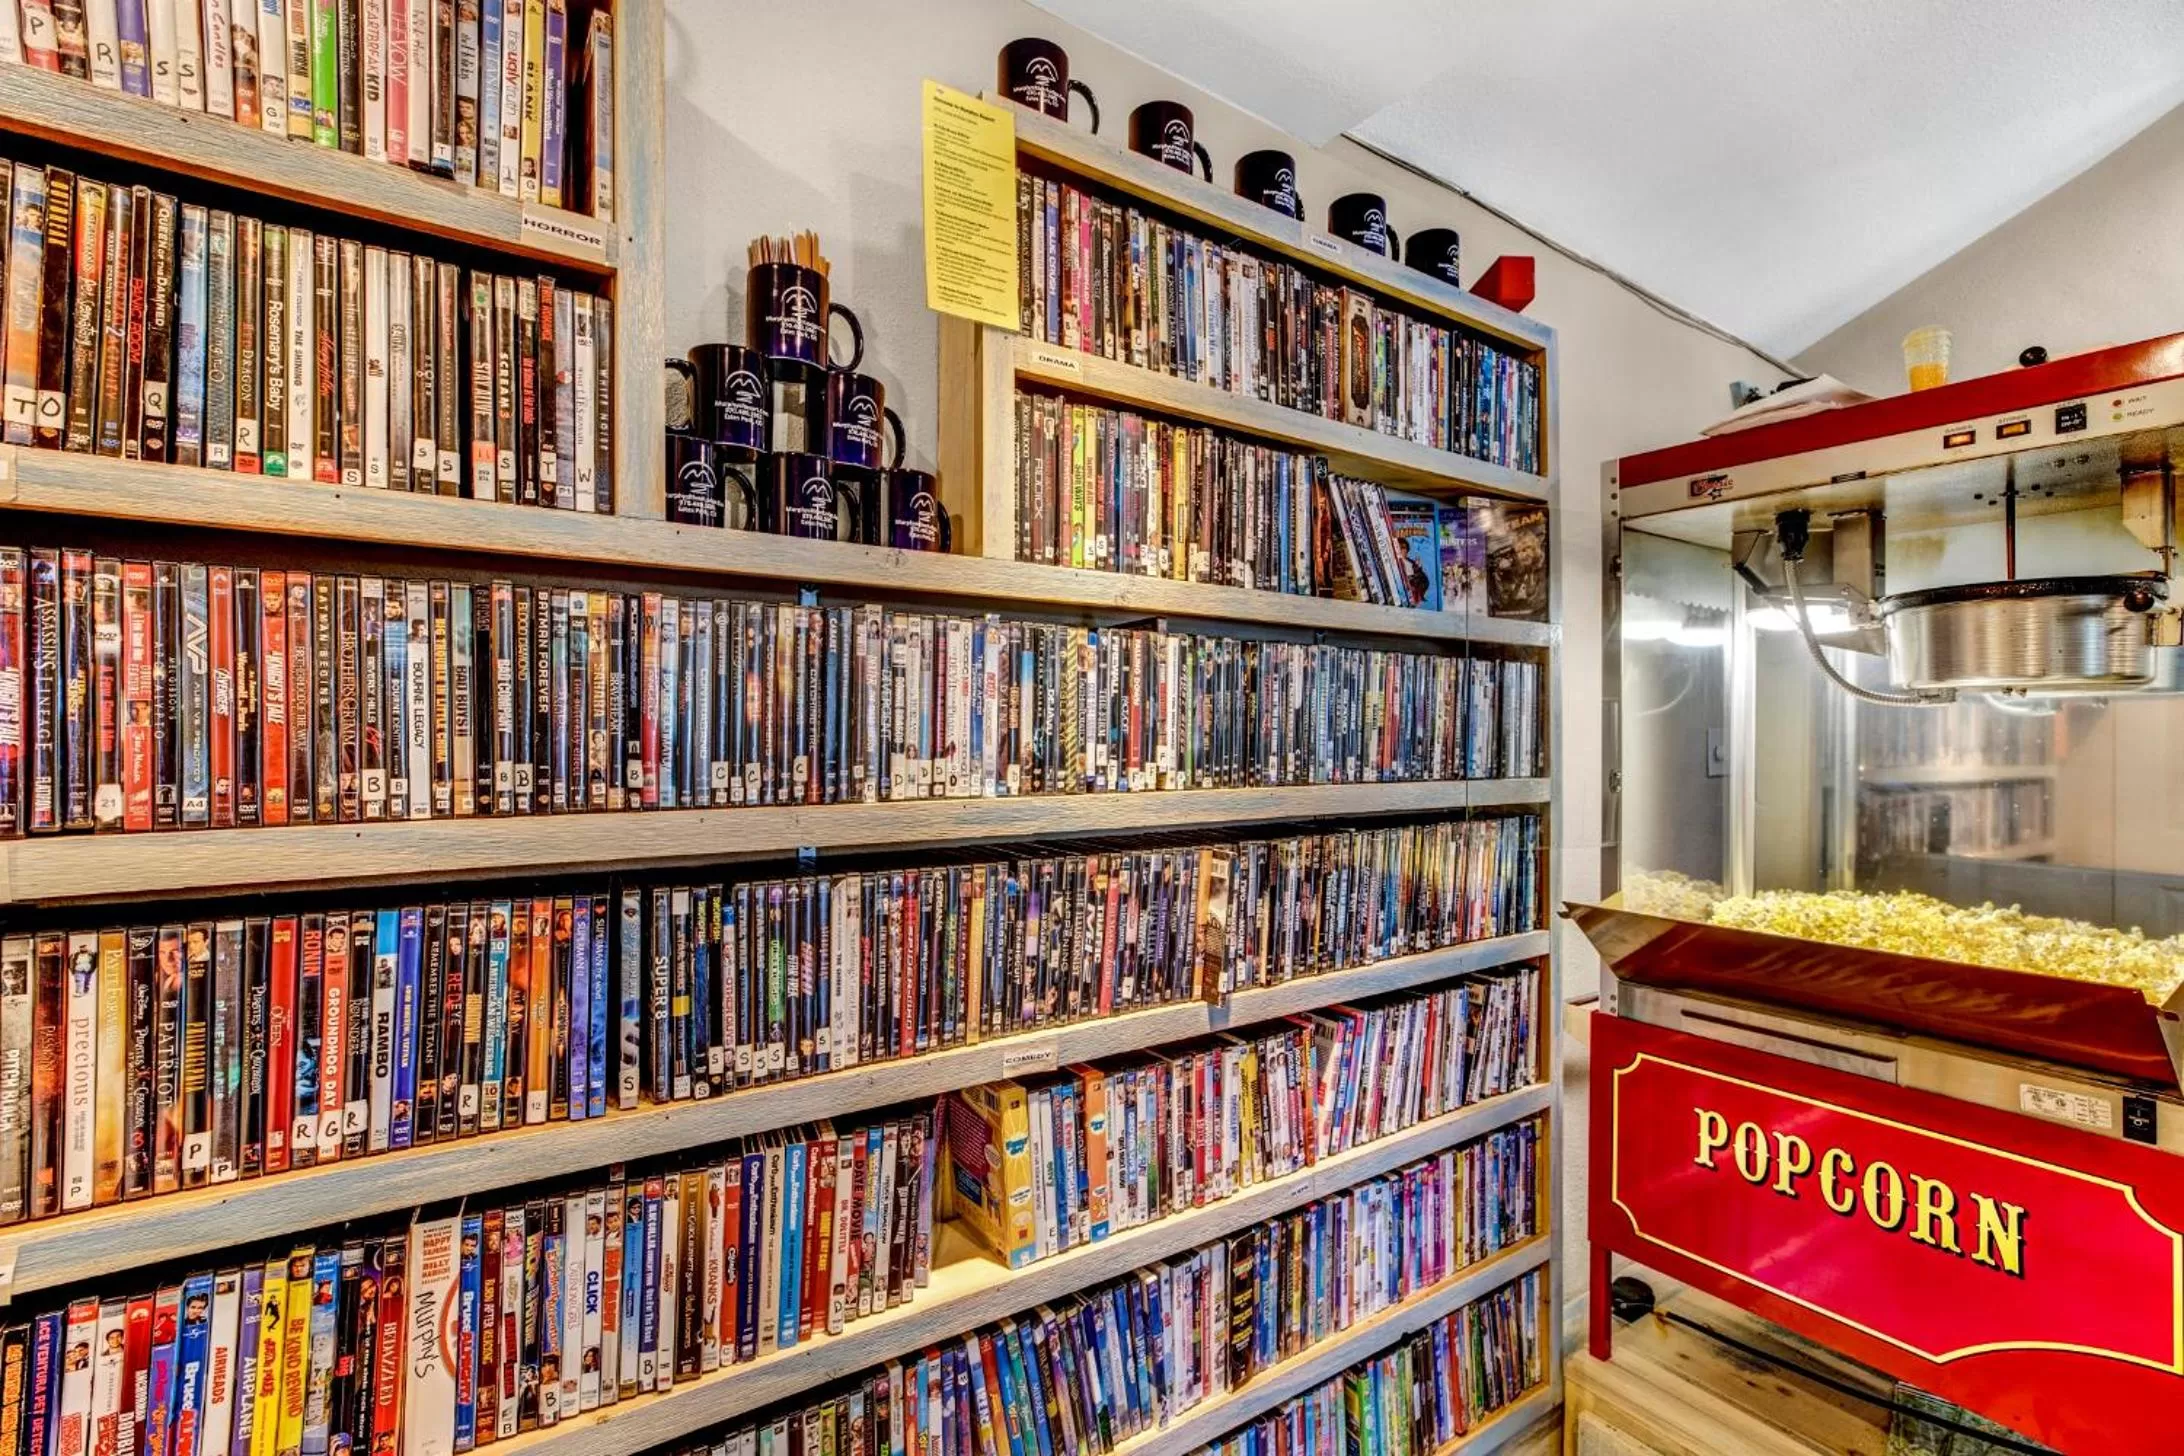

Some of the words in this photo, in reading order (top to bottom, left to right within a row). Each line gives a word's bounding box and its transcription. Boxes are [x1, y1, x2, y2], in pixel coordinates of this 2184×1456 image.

[29, 17, 44, 35] P
[213, 12, 224, 69] Candles
[96, 43, 114, 64] R
[156, 61, 169, 75] S
[178, 63, 195, 78] S
[391, 41, 406, 86] VOW
[486, 39, 499, 101] TITANIC
[502, 51, 518, 85] ugly
[266, 107, 277, 118] G
[158, 208, 170, 249] QUEEN
[523, 217, 600, 246] HORROR
[1049, 226, 1057, 255] BLUE
[1049, 256, 1057, 296] CRUSH
[131, 278, 142, 319] PANIC
[155, 276, 166, 326] DAMNED
[106, 326, 125, 336] 2
[130, 322, 141, 363] ROOM
[268, 300, 282, 374] Rosemary's
[295, 330, 303, 347] THE
[106, 336, 119, 400] ACTIVITY
[294, 349, 303, 387] SHINING
[475, 361, 488, 387] STAY
[1038, 355, 1075, 368] DRAMA
[267, 377, 281, 411] Baby
[500, 352, 509, 407] SCREAM
[599, 368, 607, 406] WHITE
[12, 398, 36, 414] T
[41, 396, 61, 417] O
[148, 393, 162, 410] Q
[476, 389, 491, 417] ALIVE
[239, 428, 249, 446] R
[599, 412, 608, 451] NOISE
[418, 448, 427, 457] S
[442, 460, 453, 471] S
[501, 457, 511, 469] S
[542, 461, 554, 475] T
[346, 471, 358, 483] S
[578, 468, 592, 483] W
[1034, 458, 1043, 521] RIDDICK
[319, 586, 328, 641] BATMAN
[435, 618, 445, 635] BIG
[518, 601, 527, 633] BLOOD
[538, 591, 548, 648] BATMAN
[187, 613, 207, 674] AVP
[435, 639, 446, 681] TROUBLE
[518, 633, 527, 681] DIAMOND
[319, 651, 329, 705] BEGINS
[342, 631, 356, 697] BROTHERS
[456, 665, 468, 690] BAD
[497, 659, 510, 680] BAD
[1111, 636, 1119, 696] FIREWALL
[154, 641, 165, 740] APOCALYPTO
[214, 668, 230, 716] AVENGERS
[392, 679, 401, 716] BOURNE
[413, 662, 423, 705] BOURNE
[538, 651, 548, 713] FOREVER
[593, 663, 604, 718] SAHARA
[1133, 678, 1141, 705] DOWN
[267, 704, 284, 725] TALE
[436, 699, 446, 729] LITTLE
[457, 694, 468, 728] BOYS
[498, 683, 511, 732] COMPANY
[610, 672, 620, 736] BRAVEHEART
[343, 697, 358, 746] GRIMM
[392, 717, 401, 750] IDENTITY
[414, 708, 425, 749] LEGACY
[436, 732, 446, 763] CHINA
[368, 777, 380, 792] B
[395, 781, 403, 791] B
[500, 772, 508, 782] B
[517, 771, 529, 787] B
[186, 799, 204, 810] A4
[935, 880, 943, 933] SYRIANA
[595, 918, 605, 968] SUPERMAN
[677, 933, 685, 957] STAR
[1060, 891, 1072, 972] HAPPENING
[303, 930, 321, 977] RONIN
[428, 941, 439, 997] REMEMBER
[787, 954, 799, 977] STAR
[1014, 920, 1023, 984] SEABISCUIT
[447, 972, 462, 1004] RED
[487, 960, 499, 1017] AMERICAN
[654, 956, 668, 1006] SUPER
[676, 960, 685, 990] WARS
[787, 978, 799, 998] TREK
[269, 1005, 284, 1047] QUEEN
[428, 999, 436, 1019] THE
[450, 1004, 462, 1026] EYE
[655, 1011, 668, 1020] 8
[326, 987, 340, 1075] GROUNDHOG
[348, 999, 361, 1057] ROUNDERS
[376, 1012, 389, 1078] RAMBO
[425, 1024, 436, 1064] TITANS
[71, 1017, 90, 1107] precious
[485, 1019, 497, 1075] WESTERNS
[740, 1051, 749, 1066] S
[770, 1048, 781, 1063] S
[1005, 1053, 1051, 1066] COMEDY
[4, 1049, 20, 1089] PITCH
[157, 1021, 175, 1109] PATRIOT
[324, 1081, 337, 1107] DAY
[624, 1076, 635, 1090] S
[1, 1091, 17, 1132] BLACK
[462, 1094, 472, 1109] R
[296, 1123, 309, 1140] R
[325, 1121, 339, 1138] G
[347, 1112, 358, 1128] R
[189, 1142, 203, 1160] P
[71, 1186, 82, 1197] P
[854, 1160, 865, 1193] DATE
[1694, 1107, 2025, 1278] POPCORN
[850, 1197, 863, 1241] MOVIE
[482, 1279, 496, 1302] BURN
[585, 1270, 599, 1315] CLICK
[707, 1259, 721, 1305] KRANKS
[462, 1291, 475, 1332] Bruce
[482, 1303, 495, 1329] AFTER
[603, 1280, 619, 1333] DADDY
[290, 1318, 305, 1334] BE
[413, 1291, 440, 1379] Murphy's
[286, 1336, 301, 1369] KIND
[379, 1322, 397, 1407] BEDAZZLED
[481, 1329, 494, 1366] READING
[212, 1346, 228, 1404] AIRHEADS
[643, 1360, 653, 1375] B
[183, 1361, 200, 1409] Bruce
[238, 1356, 257, 1440] AIRPLANE!
[285, 1371, 303, 1418] REWIND
[545, 1392, 557, 1408] B
